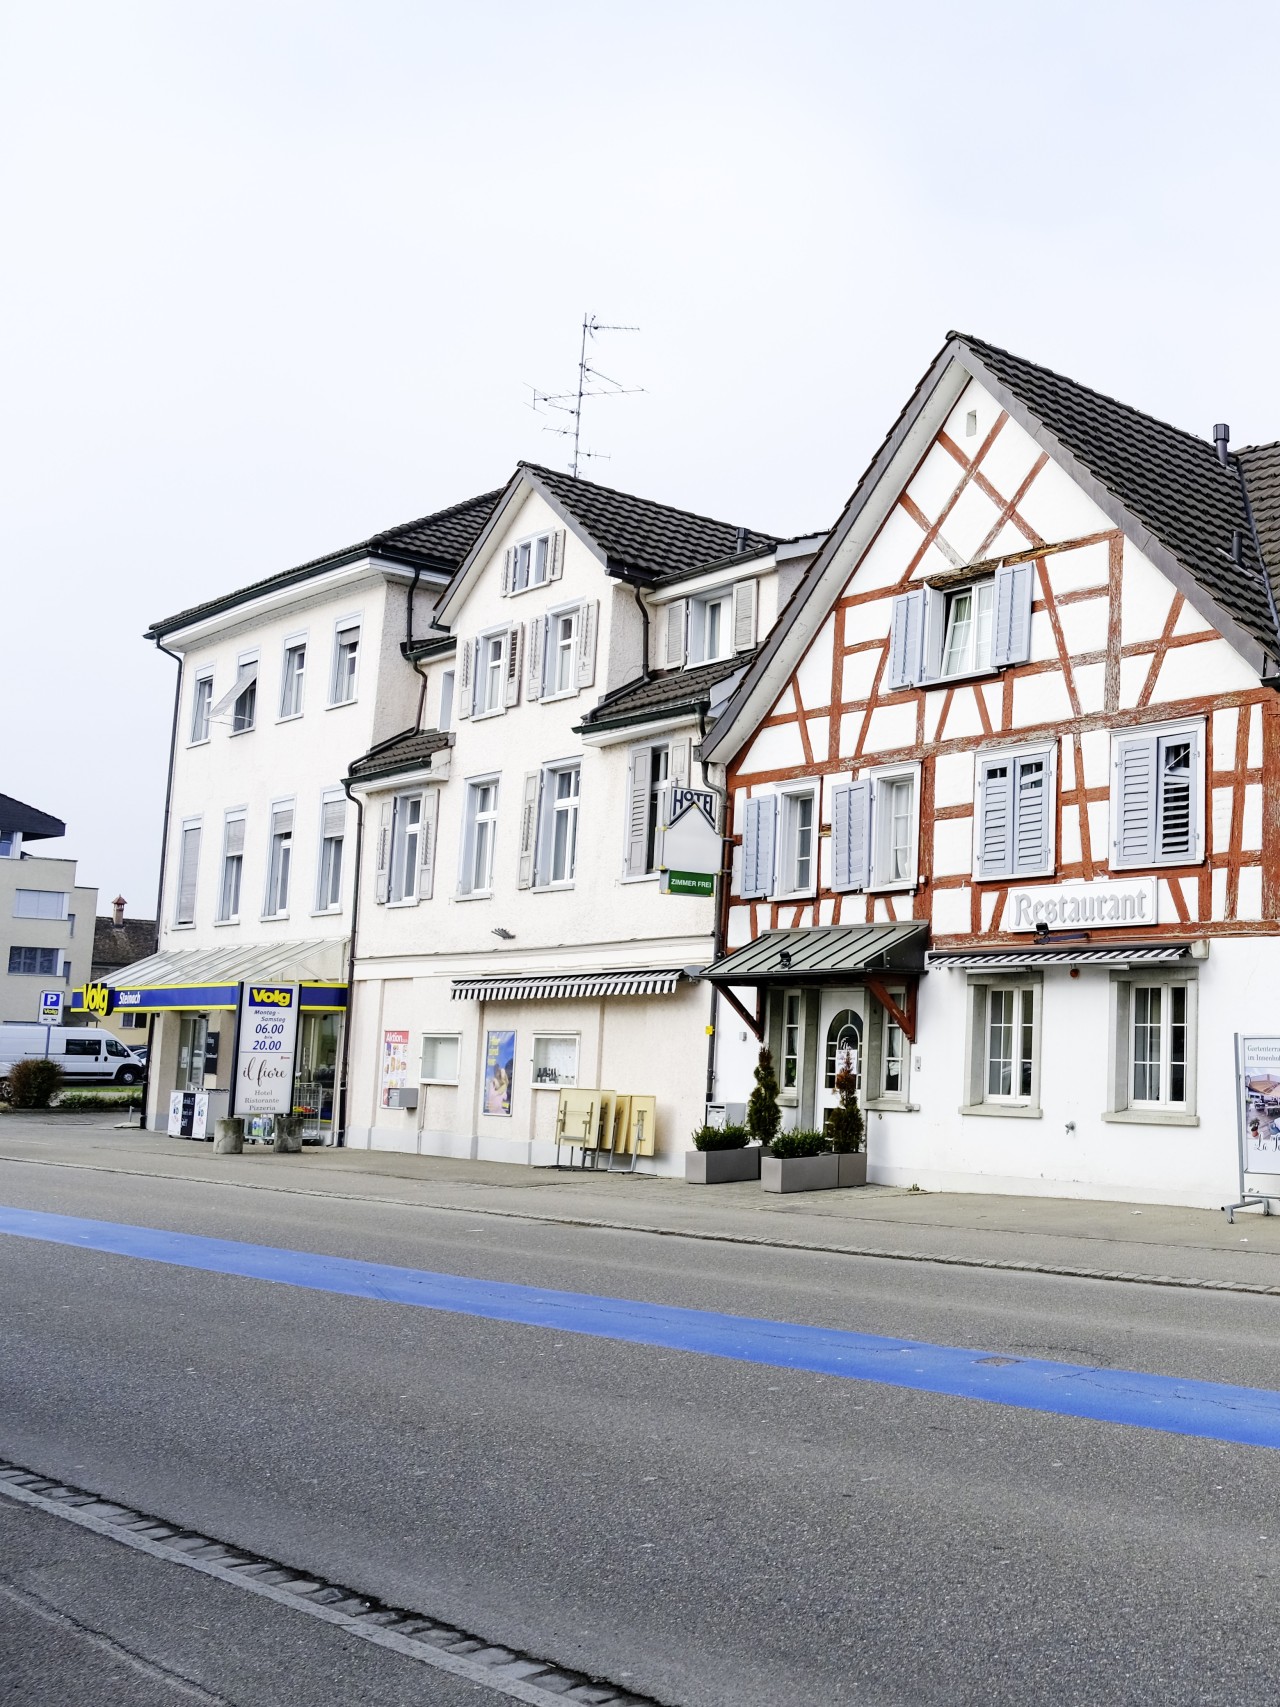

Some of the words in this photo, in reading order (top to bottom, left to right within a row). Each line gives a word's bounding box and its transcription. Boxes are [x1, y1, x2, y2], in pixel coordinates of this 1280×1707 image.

[673, 789, 715, 823] HOTEL
[670, 878, 697, 887] ZIMMER
[697, 880, 712, 888] FREI
[1014, 888, 1147, 926] Restaurant
[46, 994, 57, 1005] P
[82, 983, 109, 1016] Volg
[118, 991, 141, 1005] Steinach
[252, 988, 291, 1006] Volg
[255, 1023, 284, 1034] 06.00
[252, 1040, 282, 1051] 20.00
[243, 1056, 256, 1081] il
[257, 1059, 287, 1087] fiore
